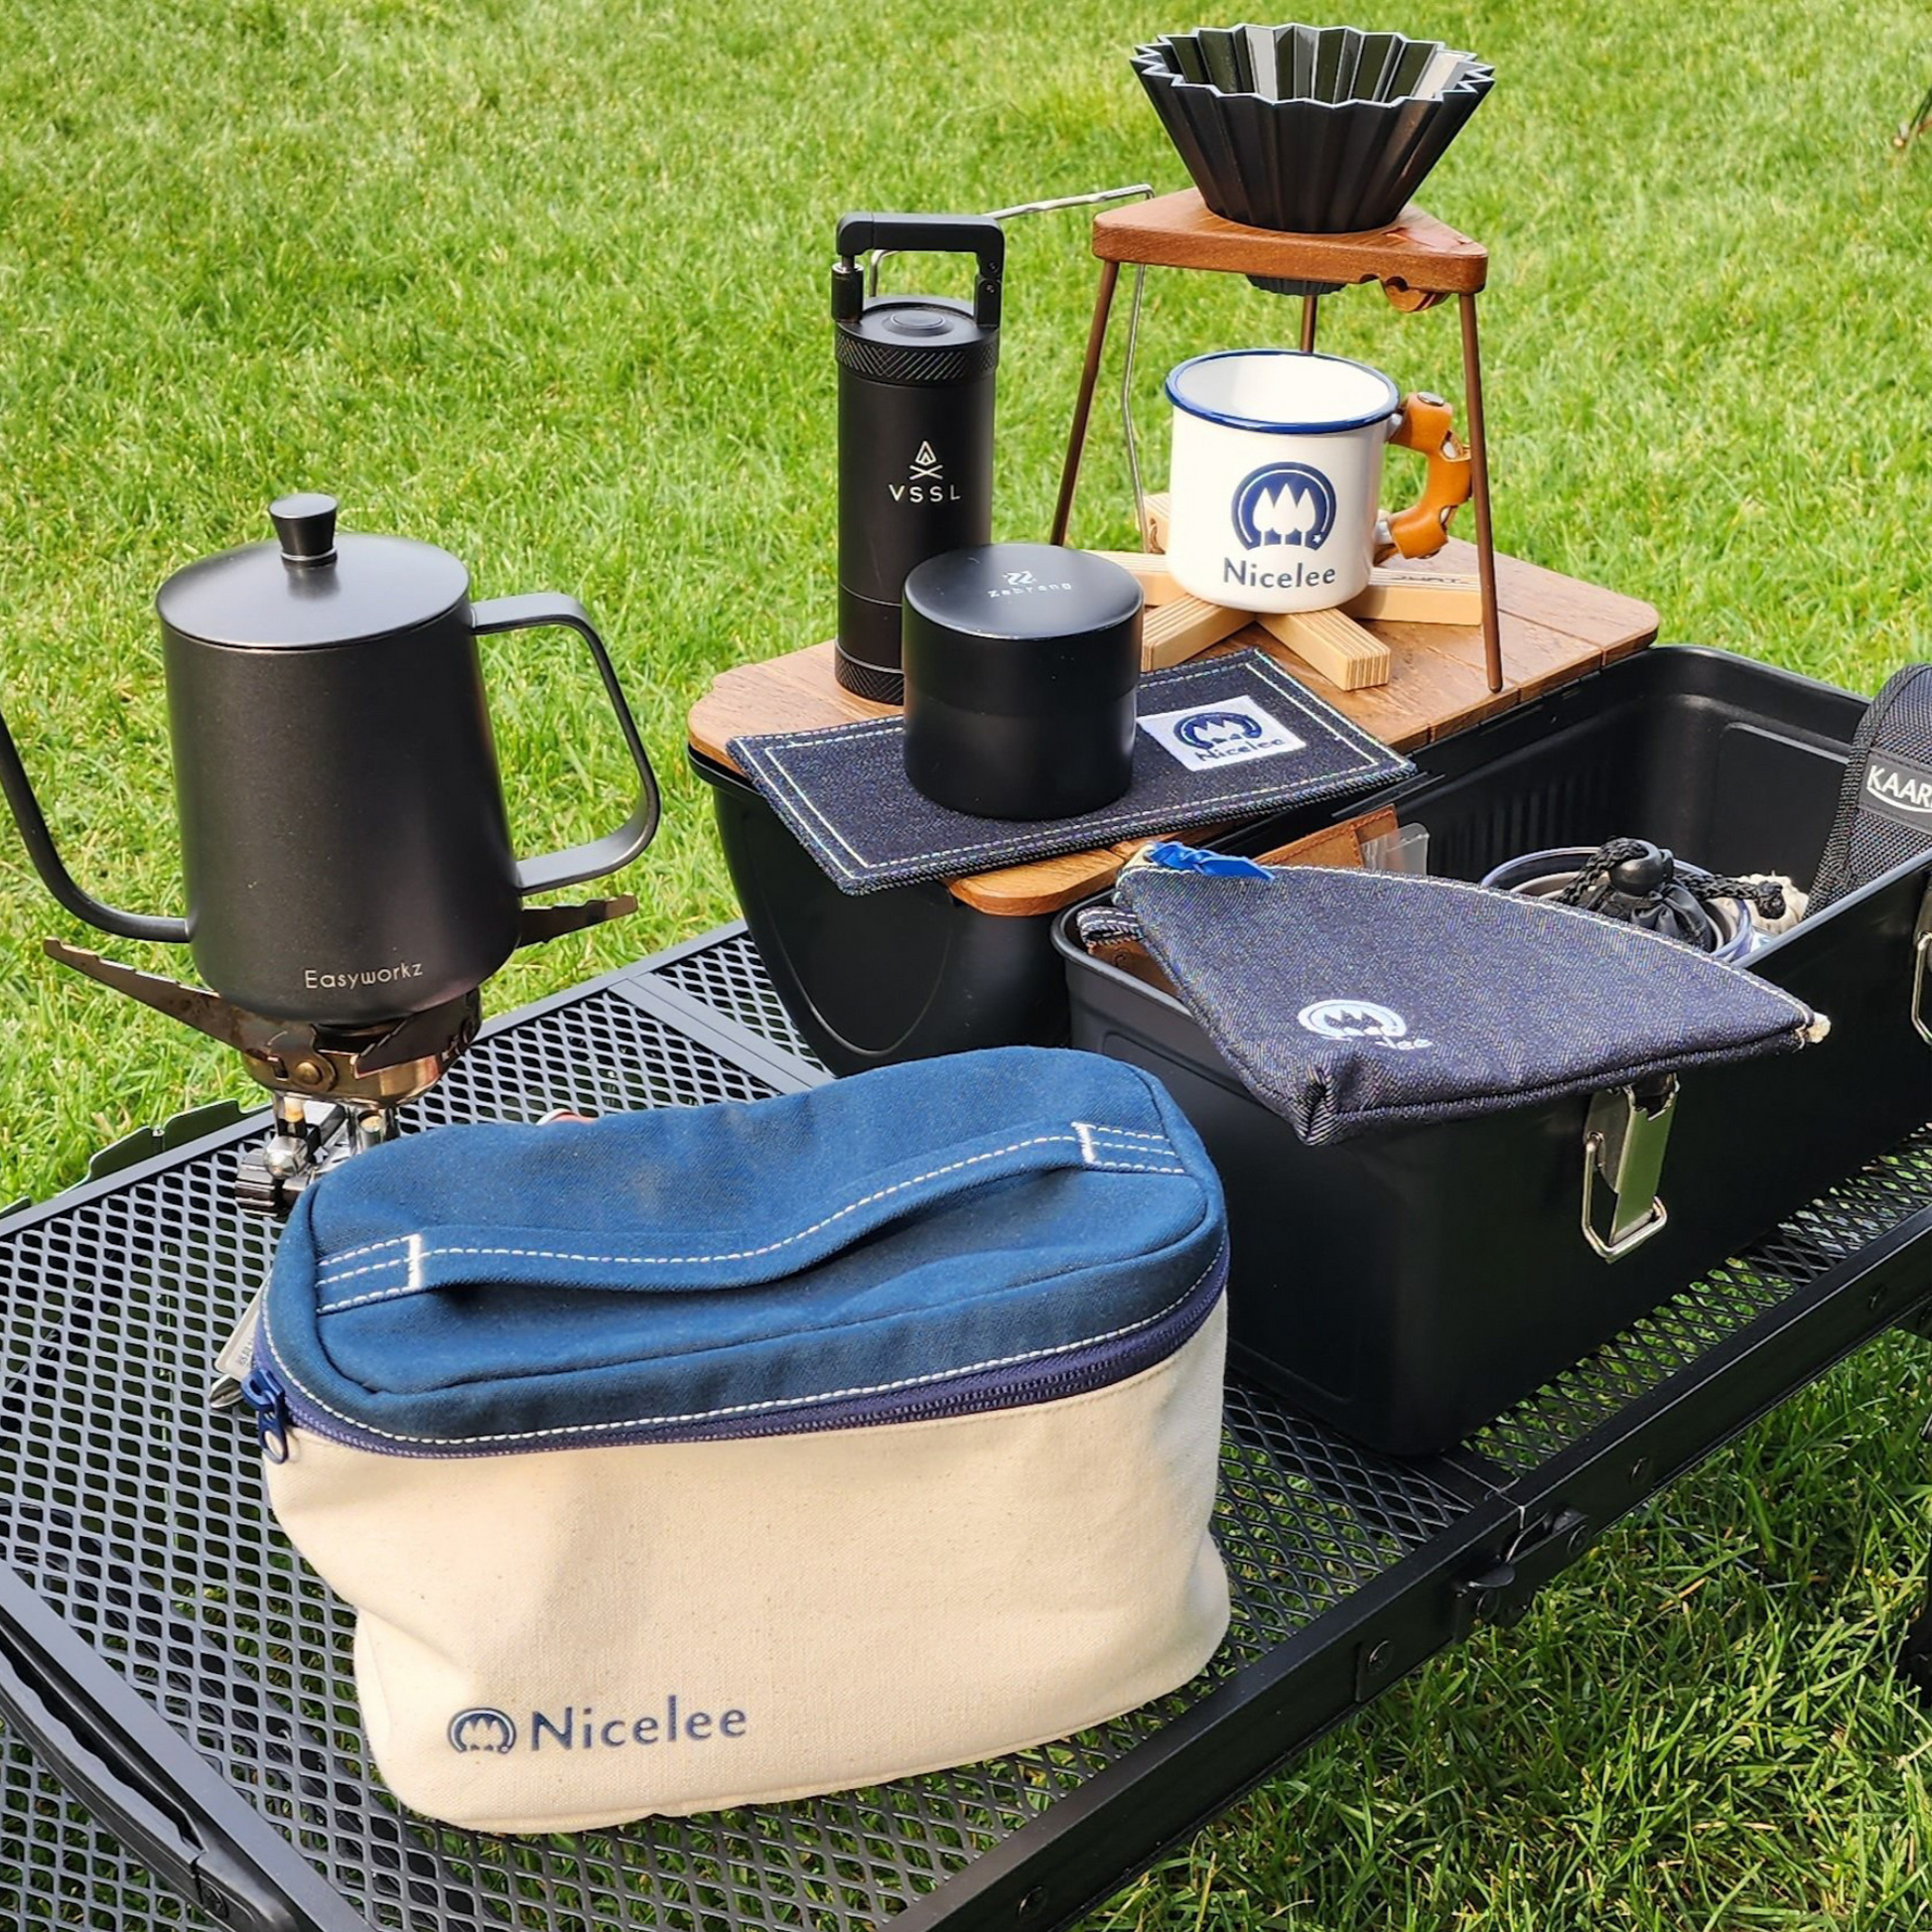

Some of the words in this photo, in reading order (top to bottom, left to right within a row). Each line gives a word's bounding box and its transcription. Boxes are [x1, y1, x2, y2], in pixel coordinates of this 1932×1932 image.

[889, 483, 961, 502] VSSL
[1223, 556, 1336, 589] Nicelee
[1866, 764, 1932, 808] KAAR
[304, 962, 424, 990] Easyworkz
[530, 1694, 748, 1751] Nicelee
